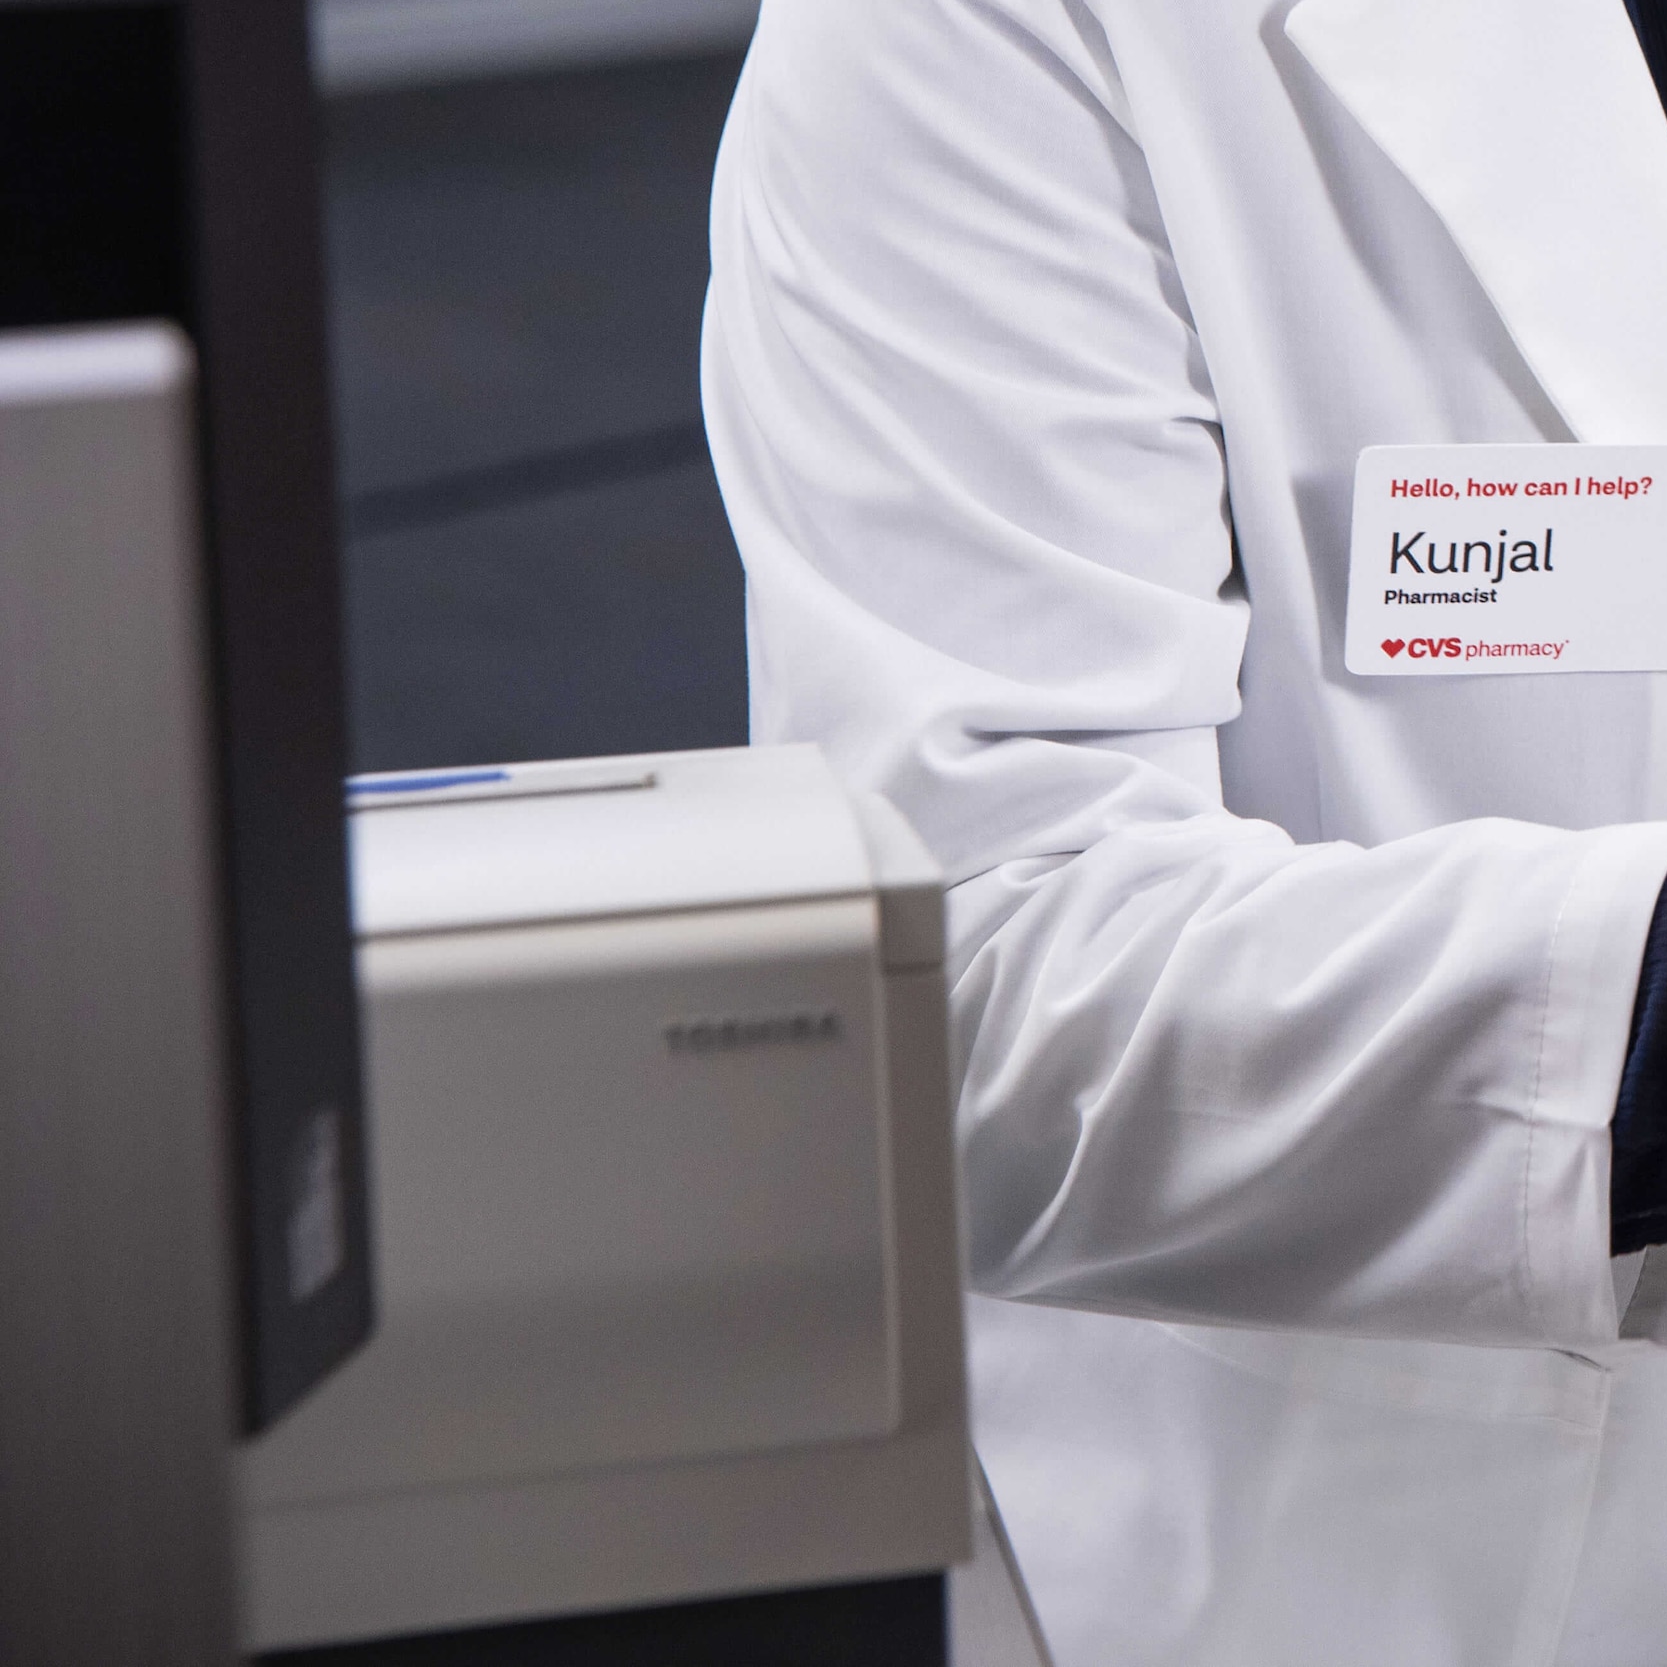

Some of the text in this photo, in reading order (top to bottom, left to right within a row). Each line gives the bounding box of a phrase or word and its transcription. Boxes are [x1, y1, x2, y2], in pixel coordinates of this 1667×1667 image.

[1390, 476, 1653, 500] Hello, how can I help?
[1390, 528, 1553, 584] Kunjal
[1384, 588, 1498, 604] Pharmacist
[1407, 637, 1565, 661] CVS pharmacy
